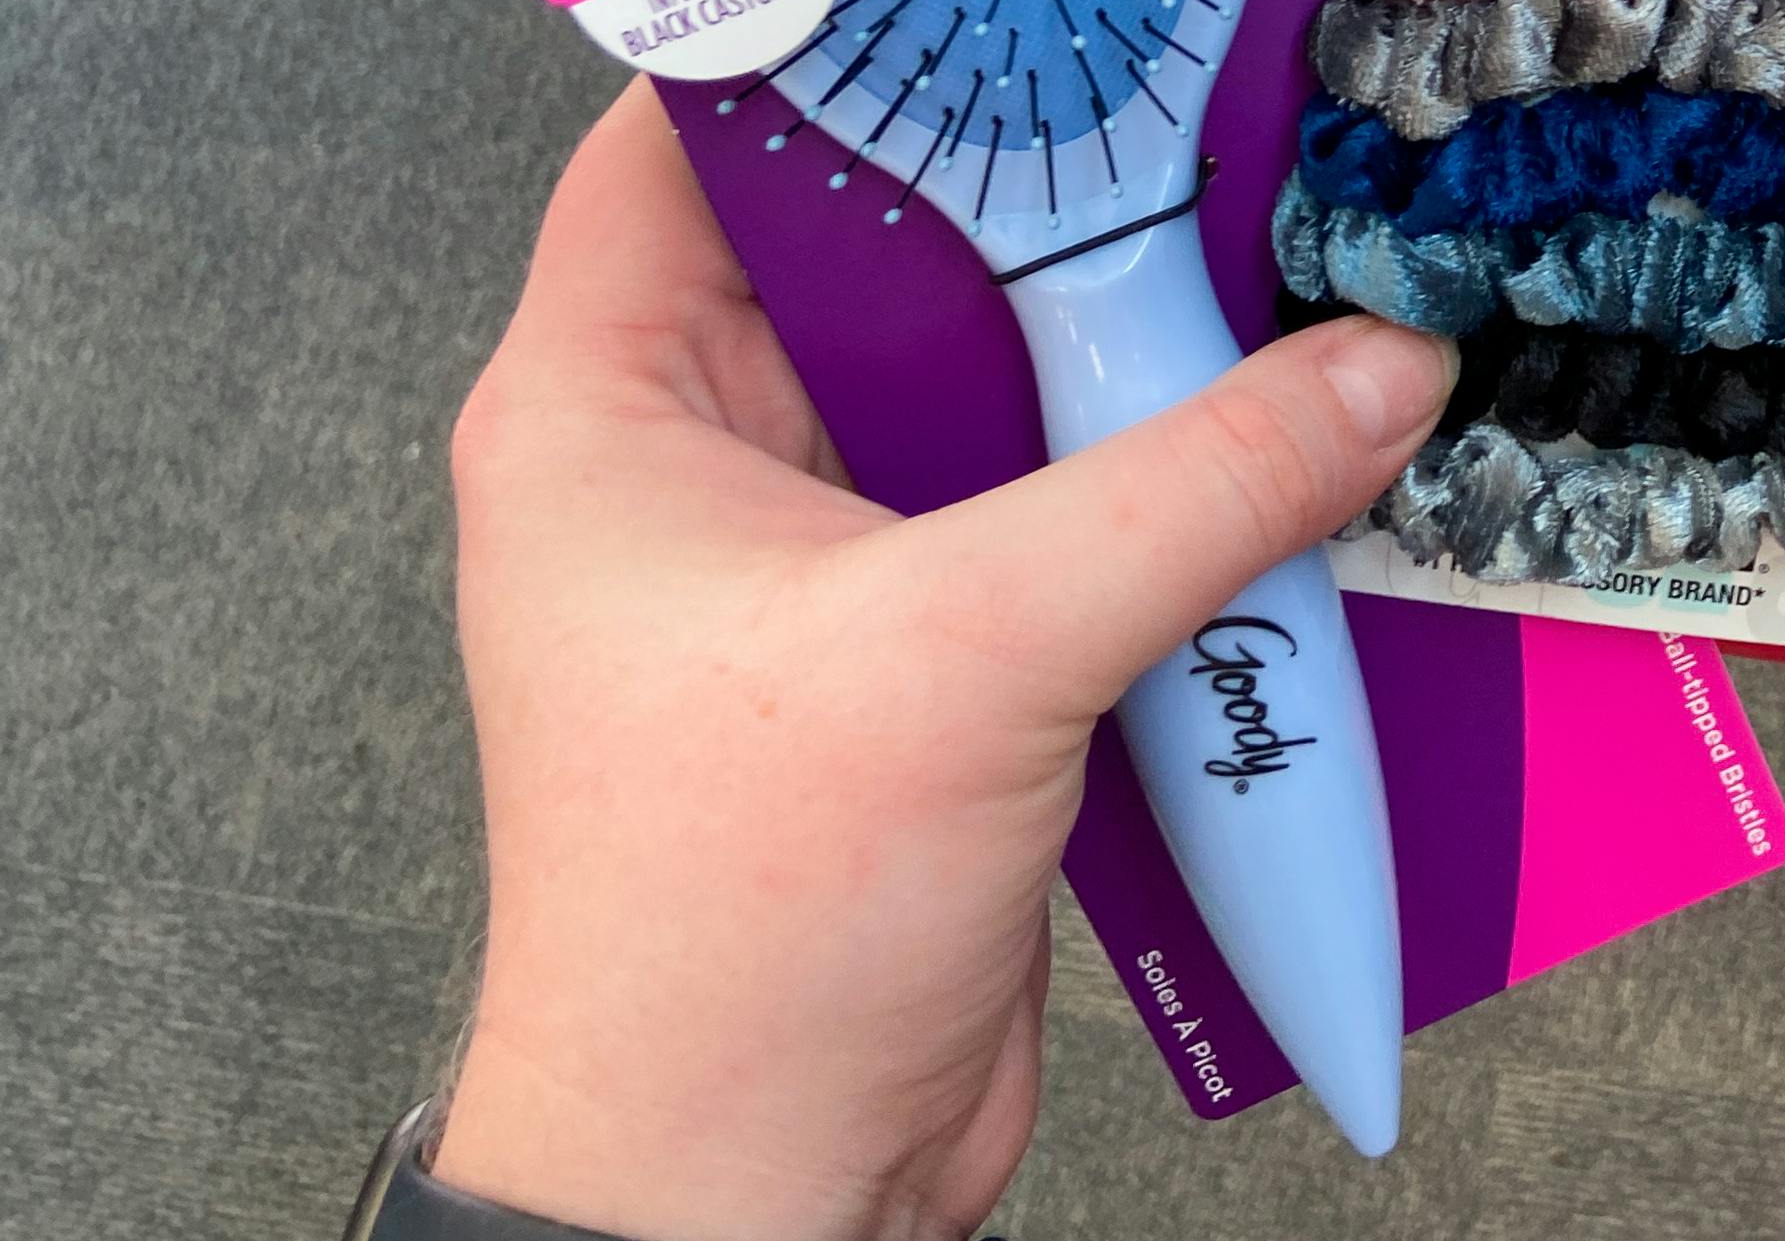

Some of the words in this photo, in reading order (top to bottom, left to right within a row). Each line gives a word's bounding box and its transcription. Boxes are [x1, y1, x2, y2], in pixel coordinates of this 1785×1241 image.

[622, 6, 699, 57] BLACK
[1189, 616, 1318, 776] Goody
[1719, 763, 1771, 856] Bristles
[1185, 1040, 1234, 1103] Picot
